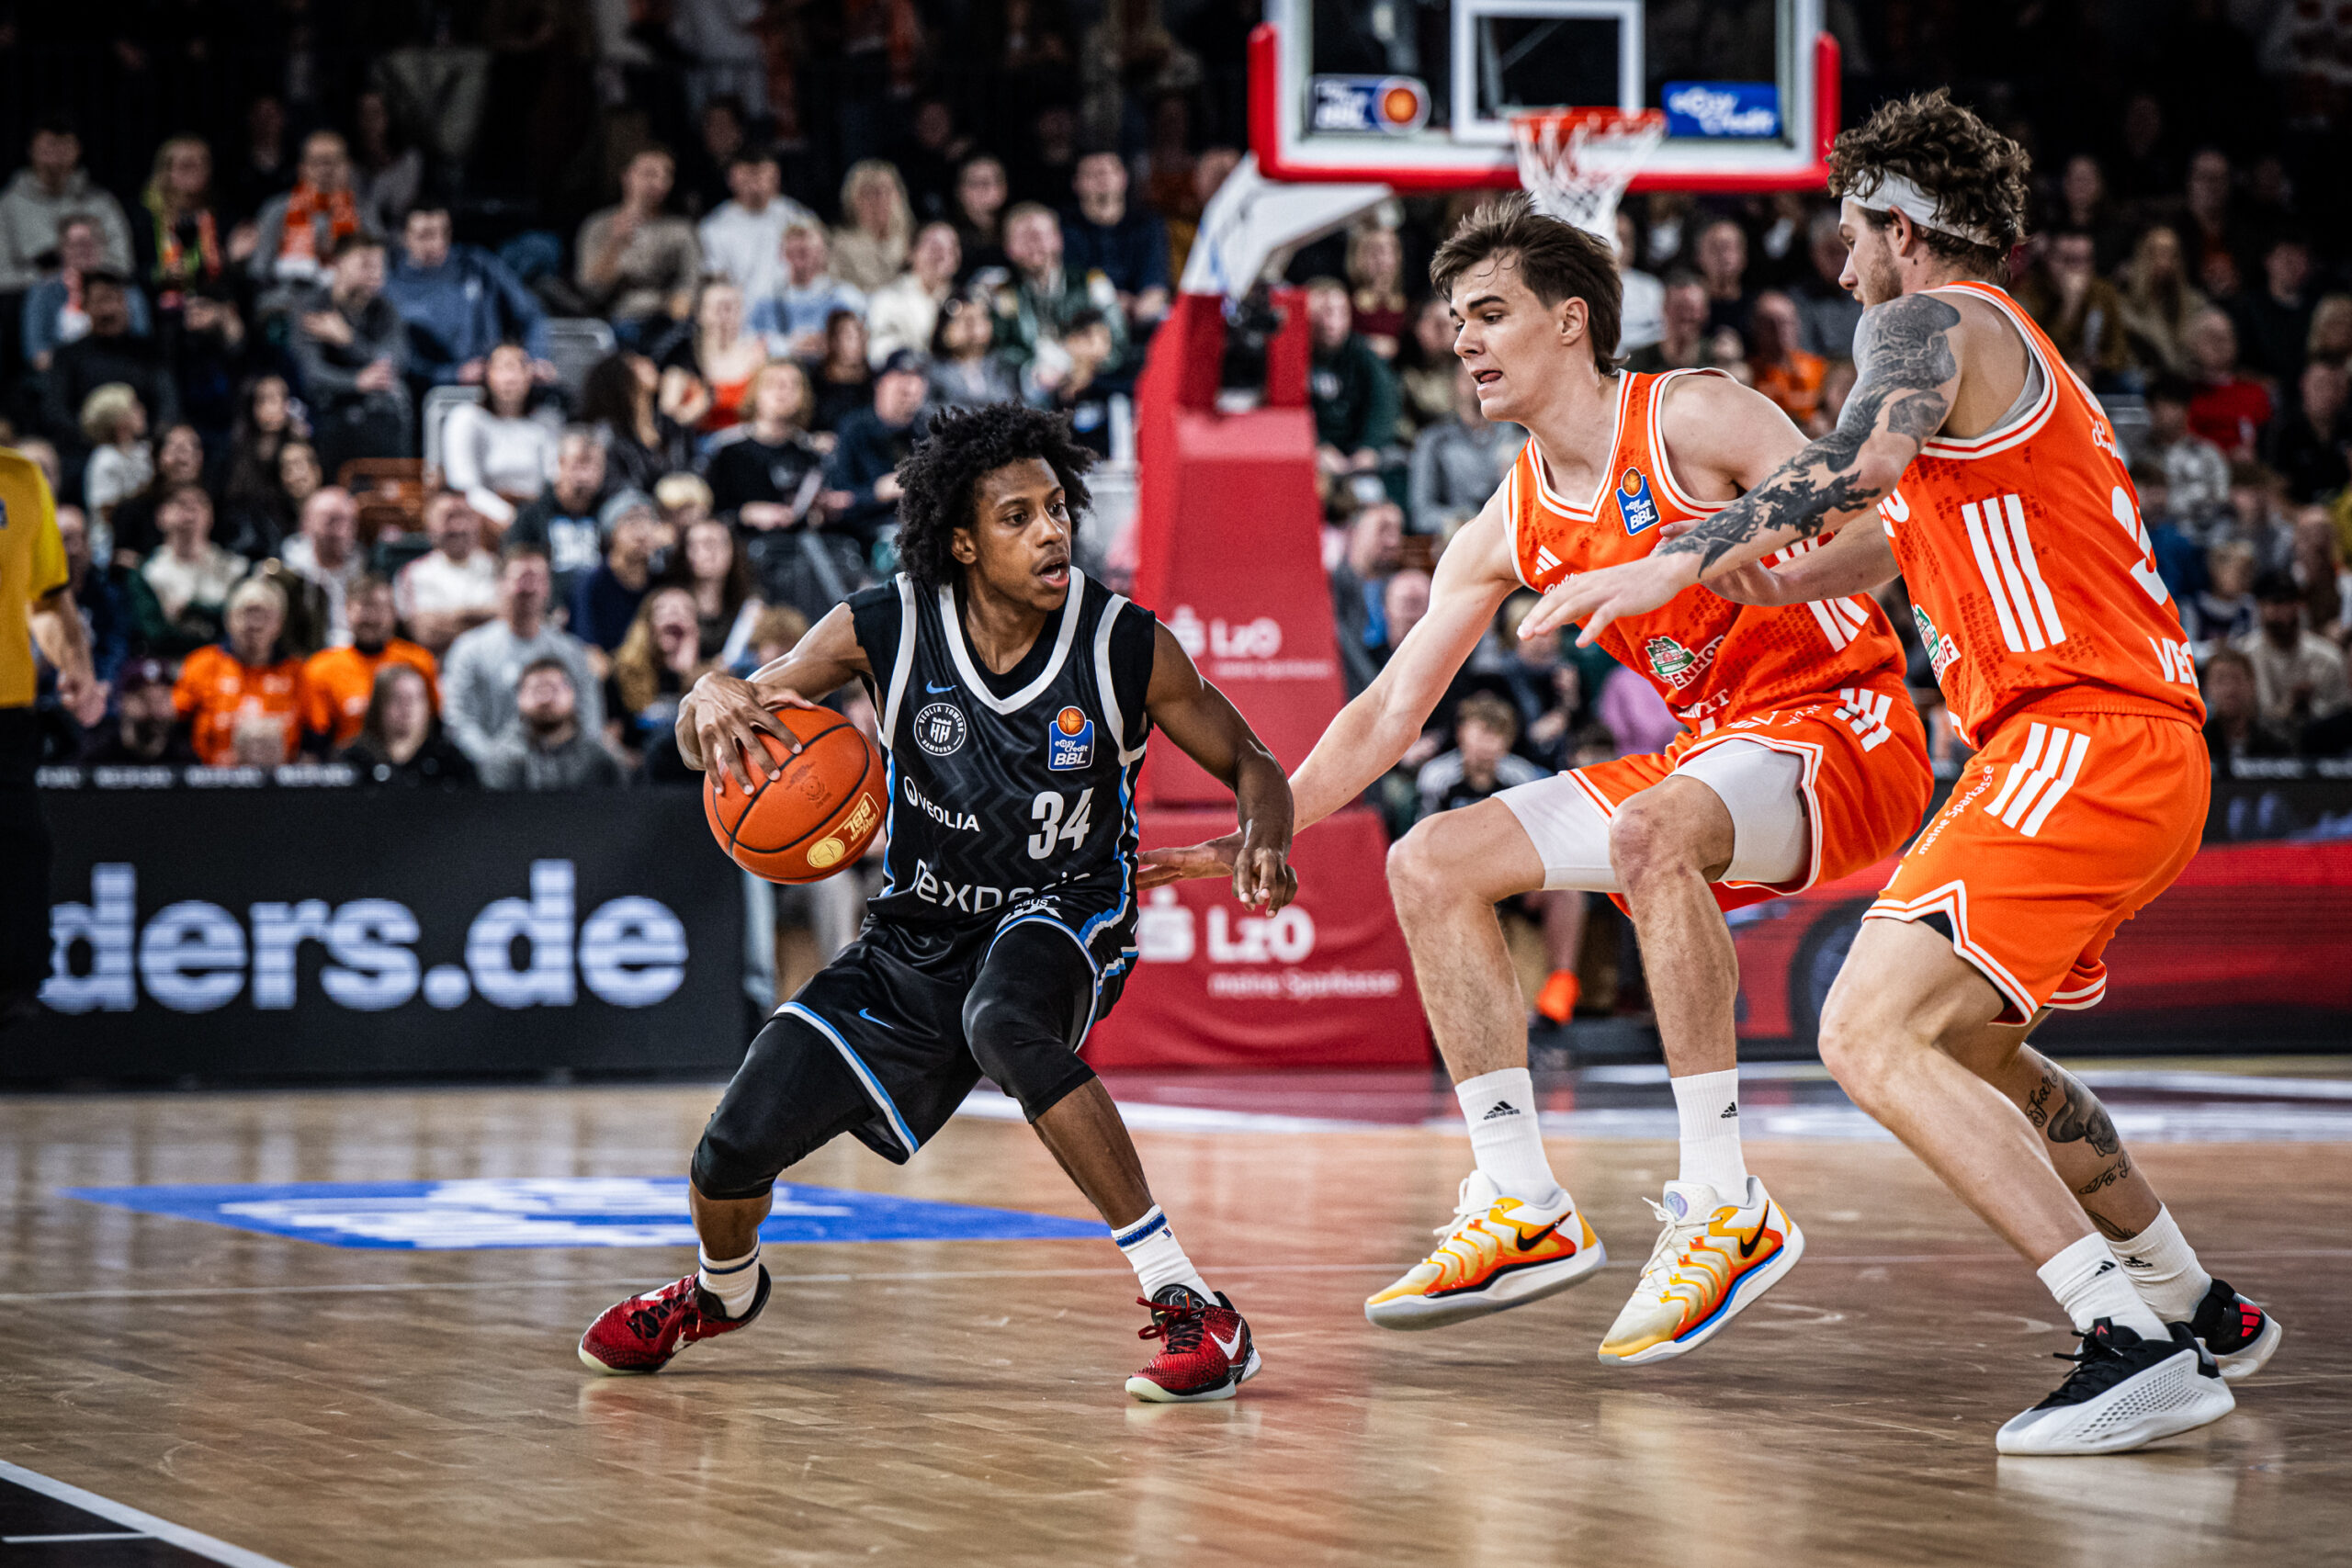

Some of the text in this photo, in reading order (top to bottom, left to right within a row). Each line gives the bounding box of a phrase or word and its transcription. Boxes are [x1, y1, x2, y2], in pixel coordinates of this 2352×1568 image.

[1630, 507, 1656, 530] BBL
[918, 705, 965, 733] VEOLIA TOWERS
[922, 739, 953, 753] HAMBURG
[1054, 751, 1086, 766] BBL
[843, 799, 872, 834] BBL
[918, 791, 981, 833] VEOLIA
[1027, 787, 1095, 861] 34
[1917, 764, 1995, 855] meine Sparkasse
[38, 858, 690, 1014] ders.de
[1483, 1109, 1521, 1121] adidas
